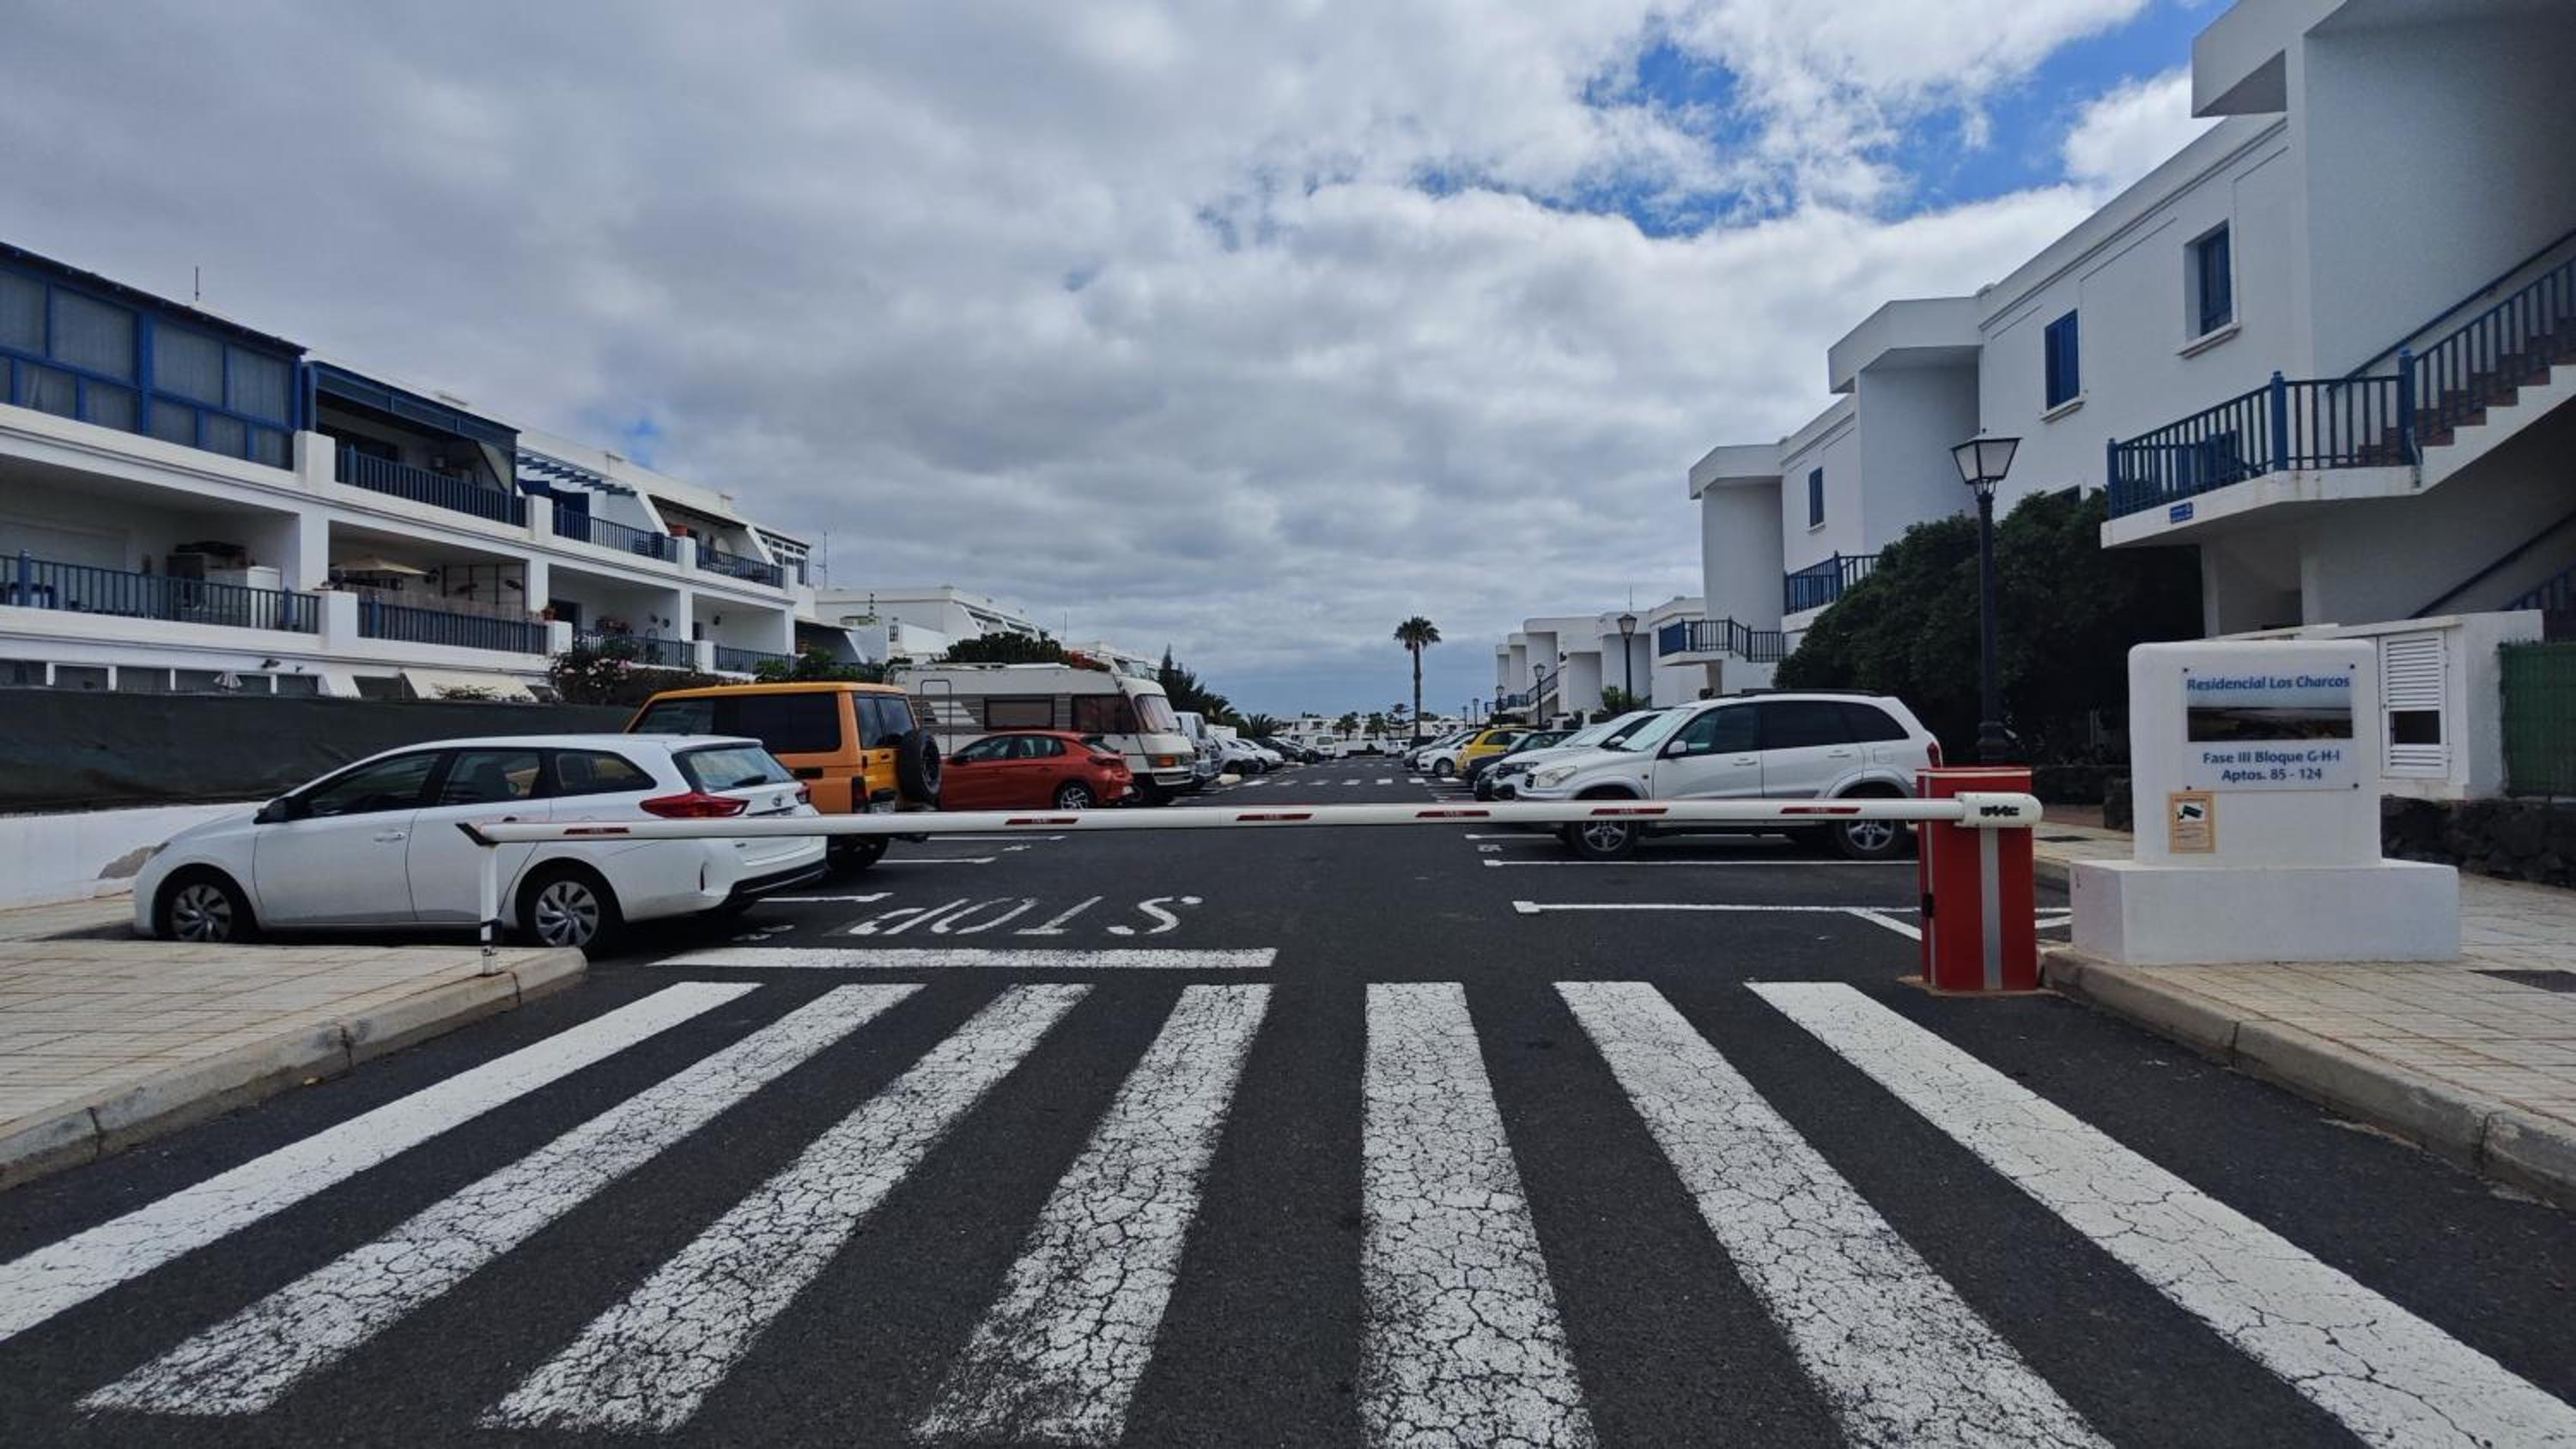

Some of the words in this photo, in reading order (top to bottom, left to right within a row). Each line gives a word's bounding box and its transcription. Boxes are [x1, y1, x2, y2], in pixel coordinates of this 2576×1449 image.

[2187, 676, 2266, 690] Residencial
[2269, 676, 2292, 688] Los
[2296, 675, 2350, 688] Charcos
[2202, 752, 2234, 764] Fase
[2239, 751, 2251, 763] III
[2255, 750, 2304, 765] Bloque
[2221, 769, 2267, 783] Aptos.
[2270, 769, 2287, 781] 85
[2300, 768, 2322, 780] 124
[846, 895, 1202, 936] STOP
